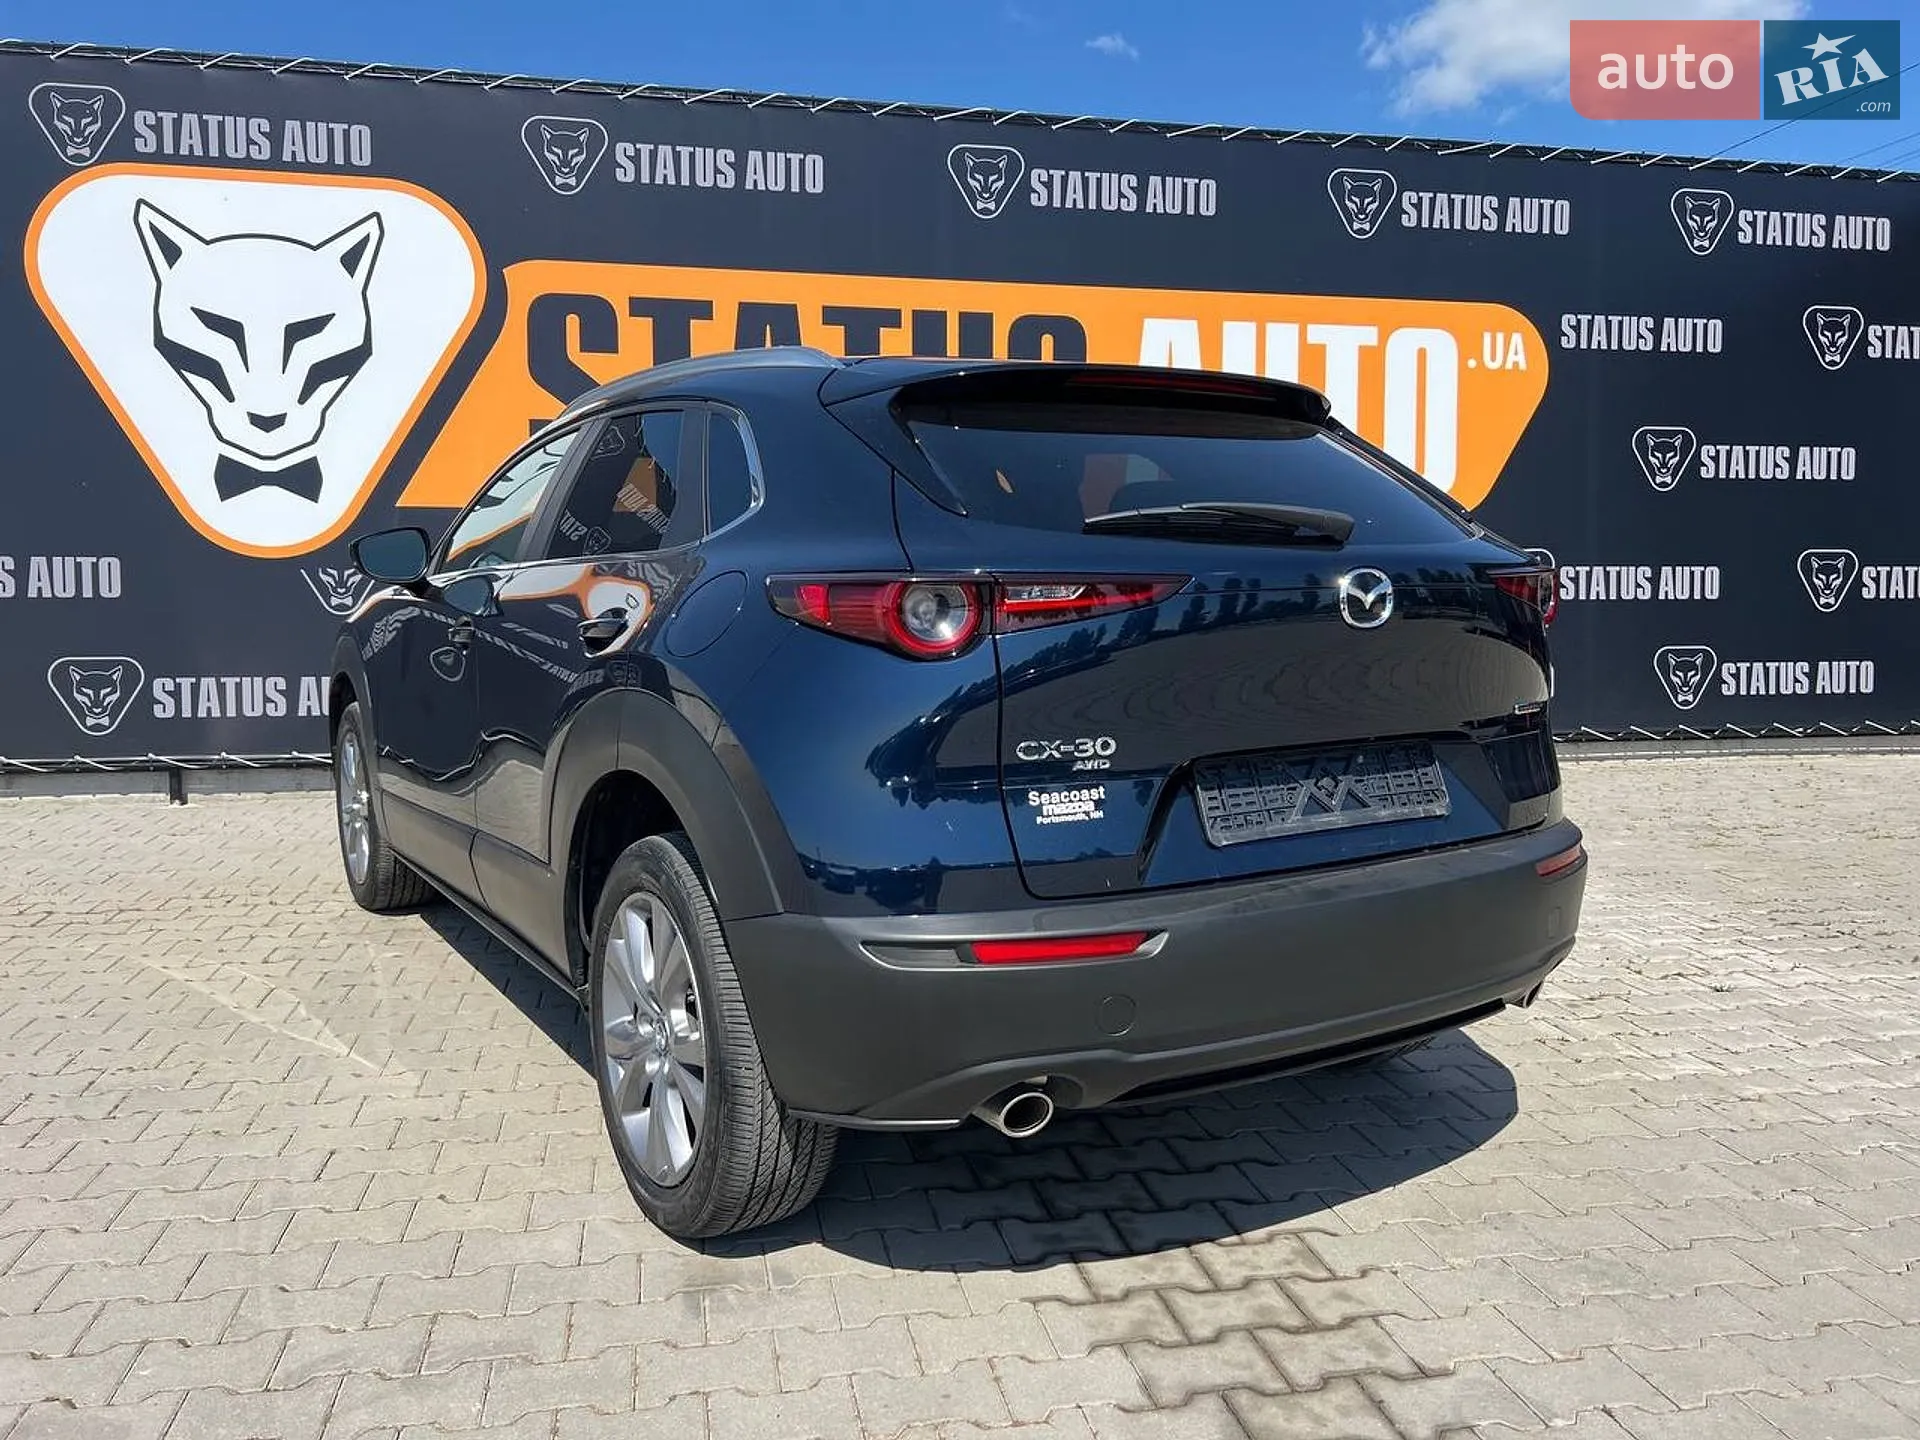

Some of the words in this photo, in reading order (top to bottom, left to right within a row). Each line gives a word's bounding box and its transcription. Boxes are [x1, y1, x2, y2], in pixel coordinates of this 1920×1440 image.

[133, 110, 271, 161] STATUS
[282, 119, 372, 167] AUTO
[614, 142, 736, 189] STATUS
[744, 150, 824, 194] AUTO
[1030, 168, 1138, 212] STATUS
[1145, 175, 1217, 217] AUTO
[1401, 191, 1499, 232] STATUS
[1504, 196, 1570, 236] AUTO
[1737, 209, 1827, 248] STATUS
[1831, 214, 1891, 252] AUTO
[1560, 313, 1655, 351] STATUS
[1660, 317, 1723, 354] AUTO
[1700, 444, 1791, 480] STATUS
[1795, 446, 1856, 480] AUTO
[27, 556, 122, 599] AUTO
[1559, 565, 1652, 600] STATUS
[1657, 565, 1720, 600] AUTO
[1861, 565, 1920, 599] STAT
[152, 676, 287, 719] STATUS
[1721, 661, 1810, 696] STATUS
[1815, 660, 1875, 695] AUTO
[1015, 736, 1117, 761] CX-30
[1027, 785, 1106, 807] Seacoast
